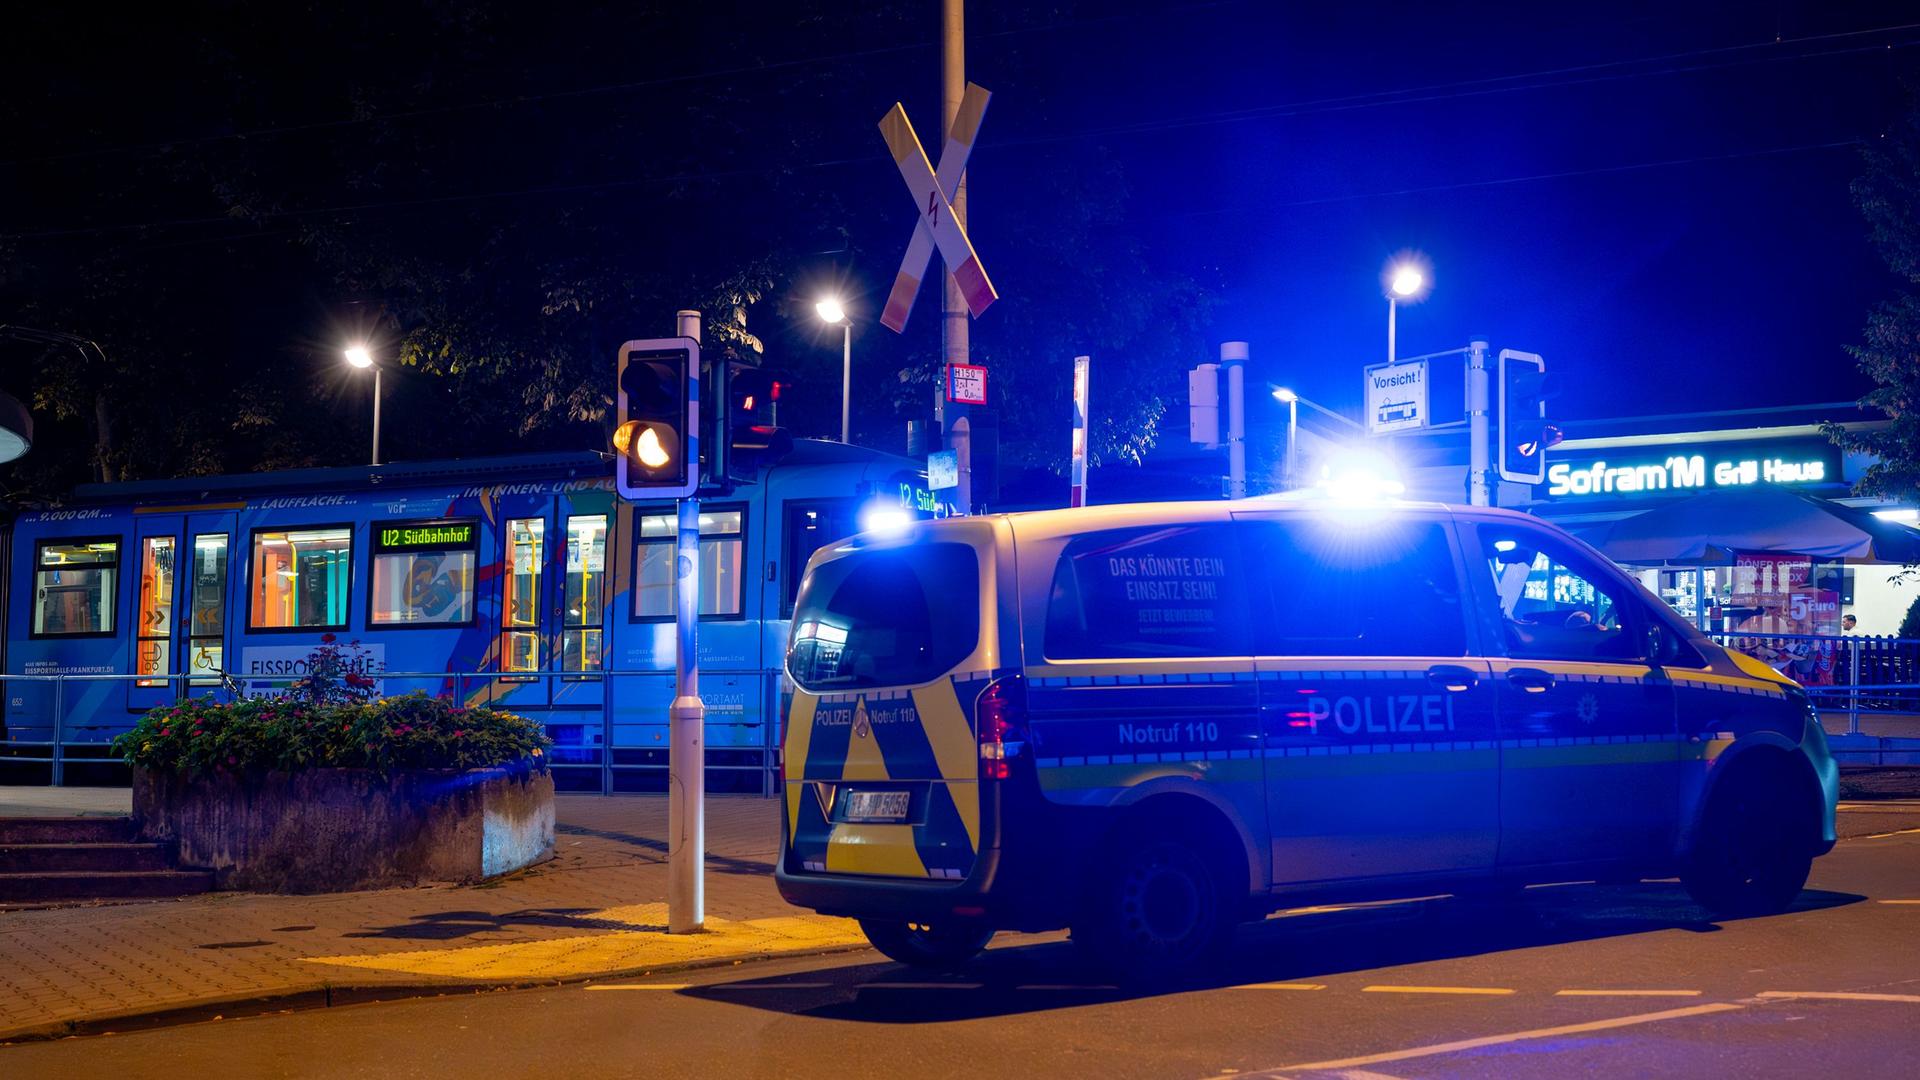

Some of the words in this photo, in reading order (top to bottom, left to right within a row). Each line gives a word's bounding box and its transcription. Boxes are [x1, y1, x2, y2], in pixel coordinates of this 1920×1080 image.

[1714, 461, 1757, 486] Grill
[1763, 459, 1824, 482] Haus
[463, 487, 484, 499] IM
[552, 480, 588, 493] UND
[39, 509, 75, 522] 9.000
[382, 529, 400, 547] U2
[404, 526, 470, 544] Südbahnhof
[1109, 557, 1137, 577] DAS
[1139, 553, 1192, 577] KÖNNTE
[1193, 557, 1225, 577] DEIN
[1126, 580, 1182, 601] EINSATZ
[1182, 580, 1218, 601] SEIN!
[1790, 593, 1807, 621] 5
[1807, 599, 1837, 612] Euro
[816, 708, 852, 726] POLIZEI
[871, 707, 898, 724] Notruf
[899, 707, 916, 723] 110
[1309, 694, 1457, 735] POLIZEI
[1118, 722, 1181, 744] Notruf
[1185, 721, 1219, 743] 110
